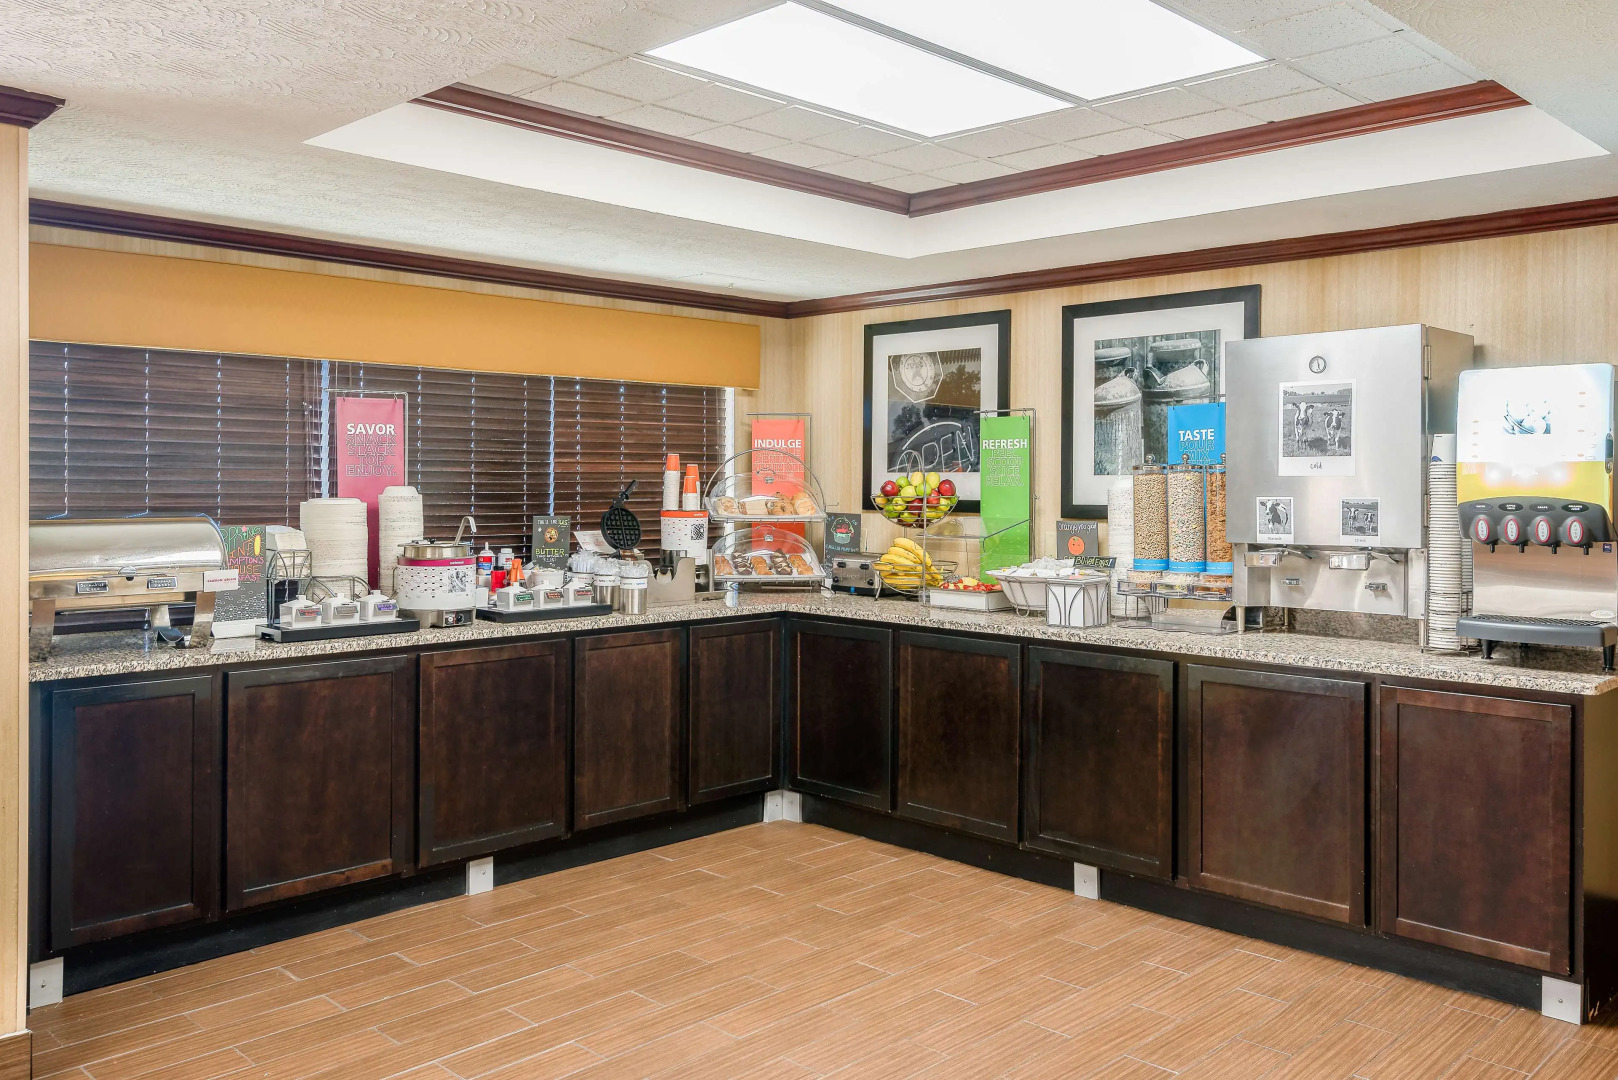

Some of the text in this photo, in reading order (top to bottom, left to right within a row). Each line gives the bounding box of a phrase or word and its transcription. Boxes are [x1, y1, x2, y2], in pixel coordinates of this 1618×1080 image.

[346, 423, 396, 435] SAVOR
[1178, 428, 1215, 441] TASTE
[345, 434, 398, 447] SNACK
[754, 438, 802, 448] INDULGE
[982, 438, 1028, 449] REFRESH
[1179, 438, 1215, 452] POUR
[347, 444, 396, 457] STACK
[1183, 449, 1210, 462] MIX
[357, 454, 386, 467] TOP
[1309, 462, 1322, 470] cold
[345, 464, 398, 477] ENJOY.
[535, 548, 565, 556] BUTTER
